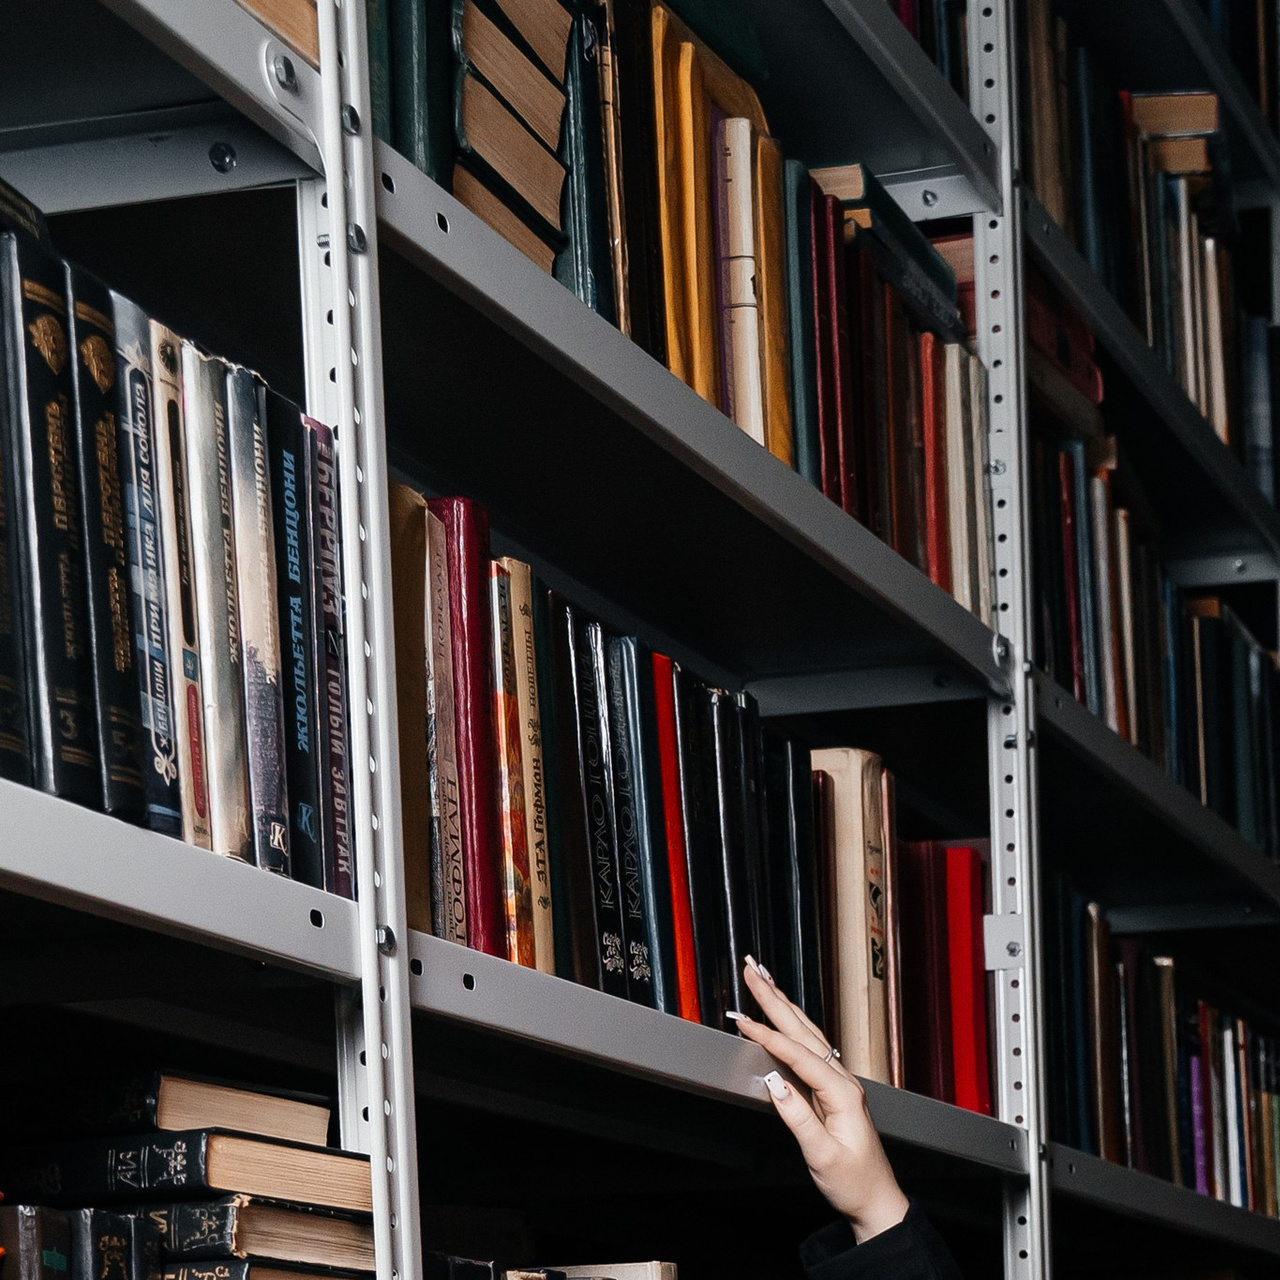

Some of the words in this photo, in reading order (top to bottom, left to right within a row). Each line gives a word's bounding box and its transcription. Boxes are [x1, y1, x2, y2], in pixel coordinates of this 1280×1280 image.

[131, 452, 153, 517] ДЛЯ
[212, 399, 231, 551] БЕНЦОНИ
[282, 449, 303, 582] БЕНЦОНИ
[137, 522, 165, 652] ПРИМАНКА
[220, 563, 242, 665] ЖЮЛЬЕТТА
[289, 597, 312, 750] ЖЮЛЬЕТТА
[325, 668, 347, 756] ГОЛЫЙ
[331, 767, 355, 880] ЗАВТРАК
[446, 774, 467, 942] ГОФМАН
